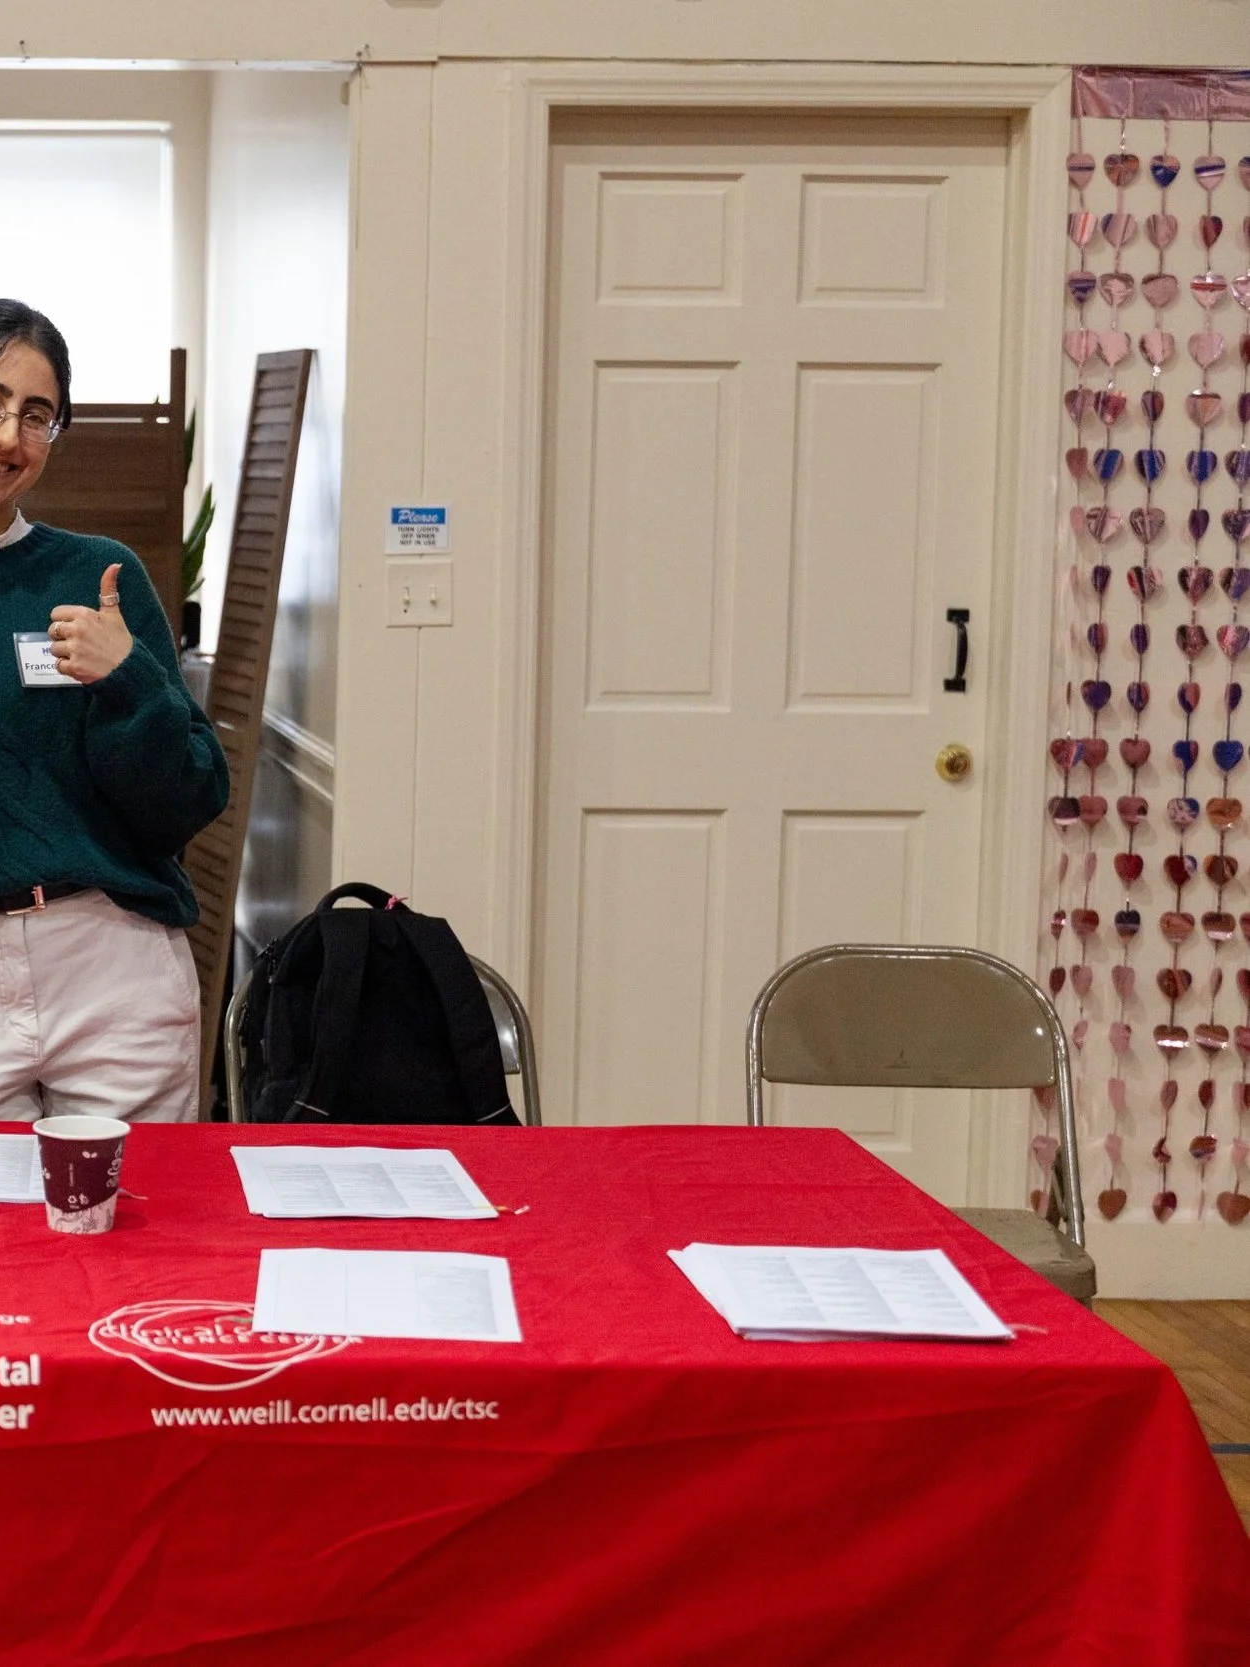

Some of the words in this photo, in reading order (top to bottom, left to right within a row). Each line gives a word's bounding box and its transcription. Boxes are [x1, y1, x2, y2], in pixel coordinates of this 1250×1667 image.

[397, 509, 439, 524] Please
[24, 662, 56, 671] France
[151, 1396, 500, 1427] www.weill.cornell.edu/ctsc
